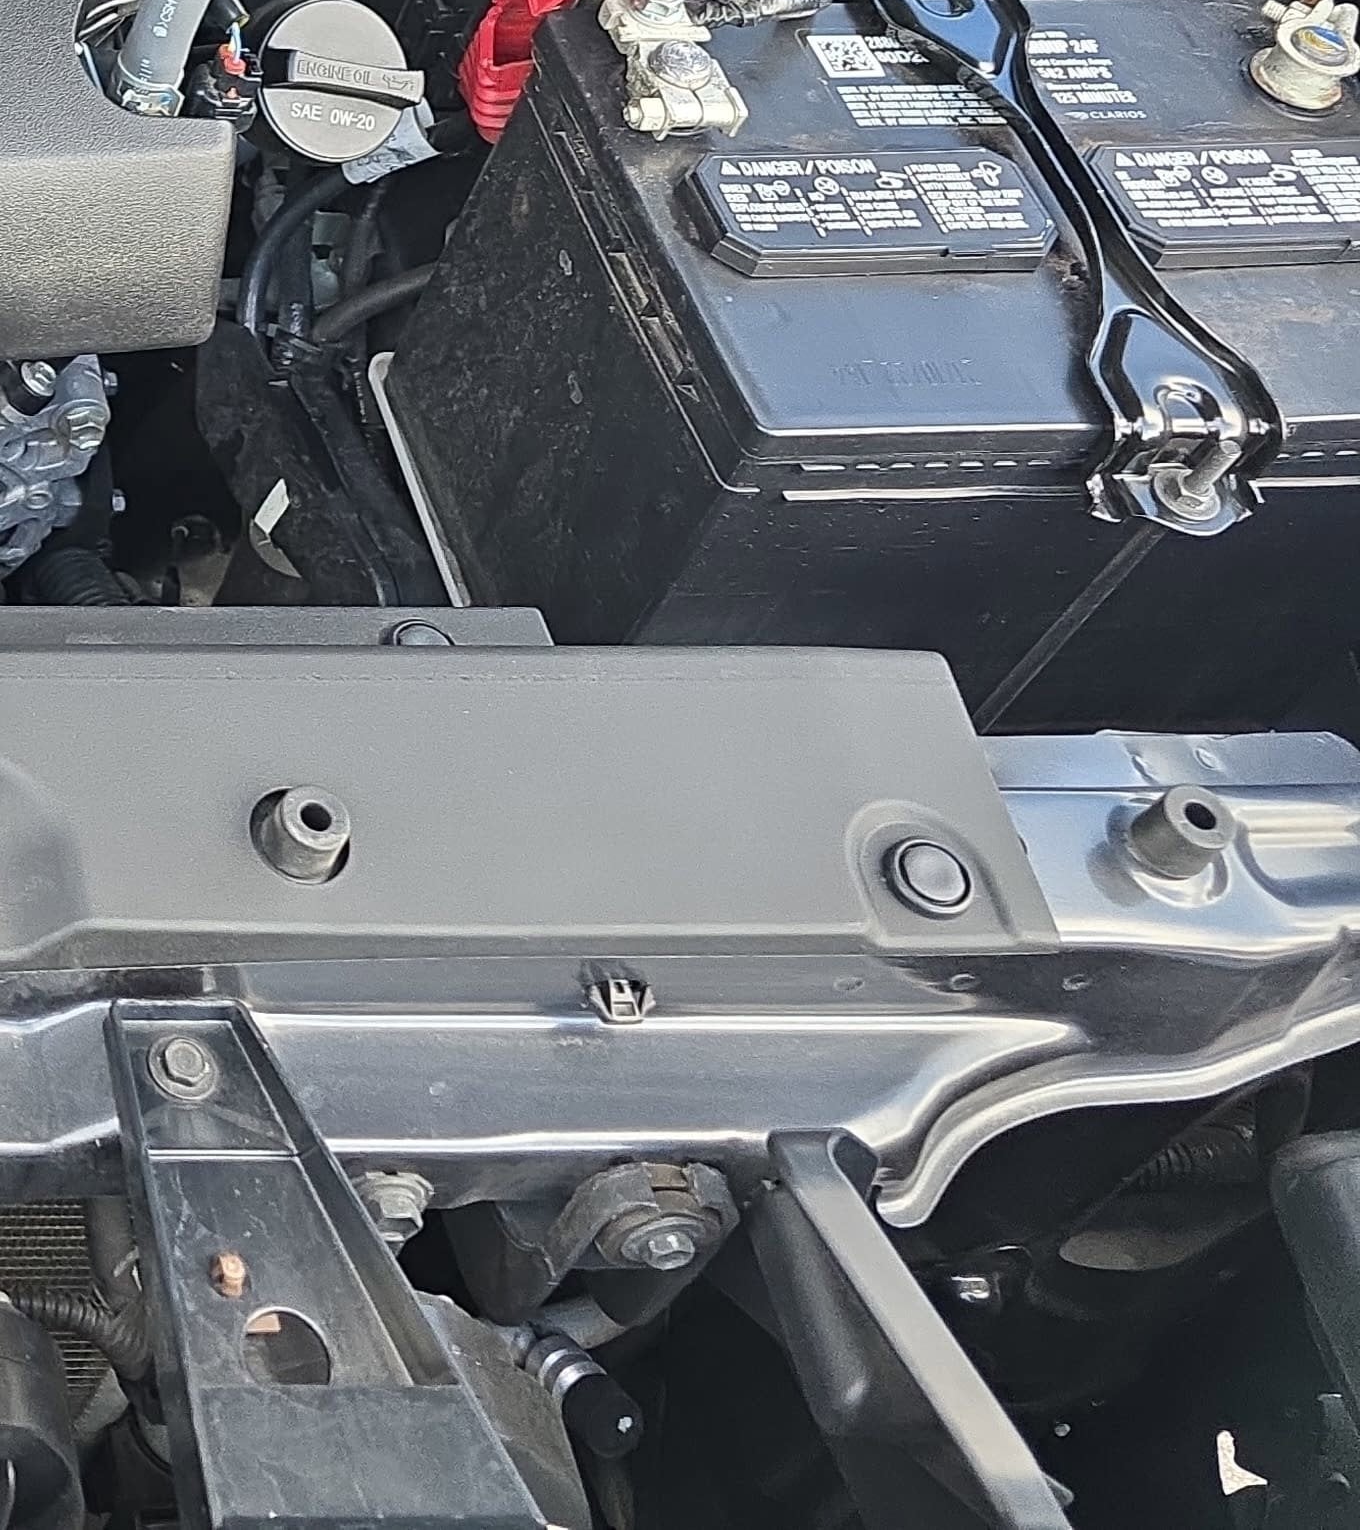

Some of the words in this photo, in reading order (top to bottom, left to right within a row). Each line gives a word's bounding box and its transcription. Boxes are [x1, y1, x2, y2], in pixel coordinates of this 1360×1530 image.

[296, 59, 354, 82] ENGINE
[353, 68, 377, 86] OIL
[1068, 66, 1113, 79] AMPS
[1077, 90, 1137, 103] MINUTES
[290, 102, 323, 121] SAE
[330, 108, 376, 131] 0W-20
[1089, 110, 1147, 119] CLARIOS
[738, 160, 804, 176] DANGER
[814, 158, 878, 174] POISON
[1133, 151, 1199, 167] DANGER
[1207, 149, 1272, 165] POISON
